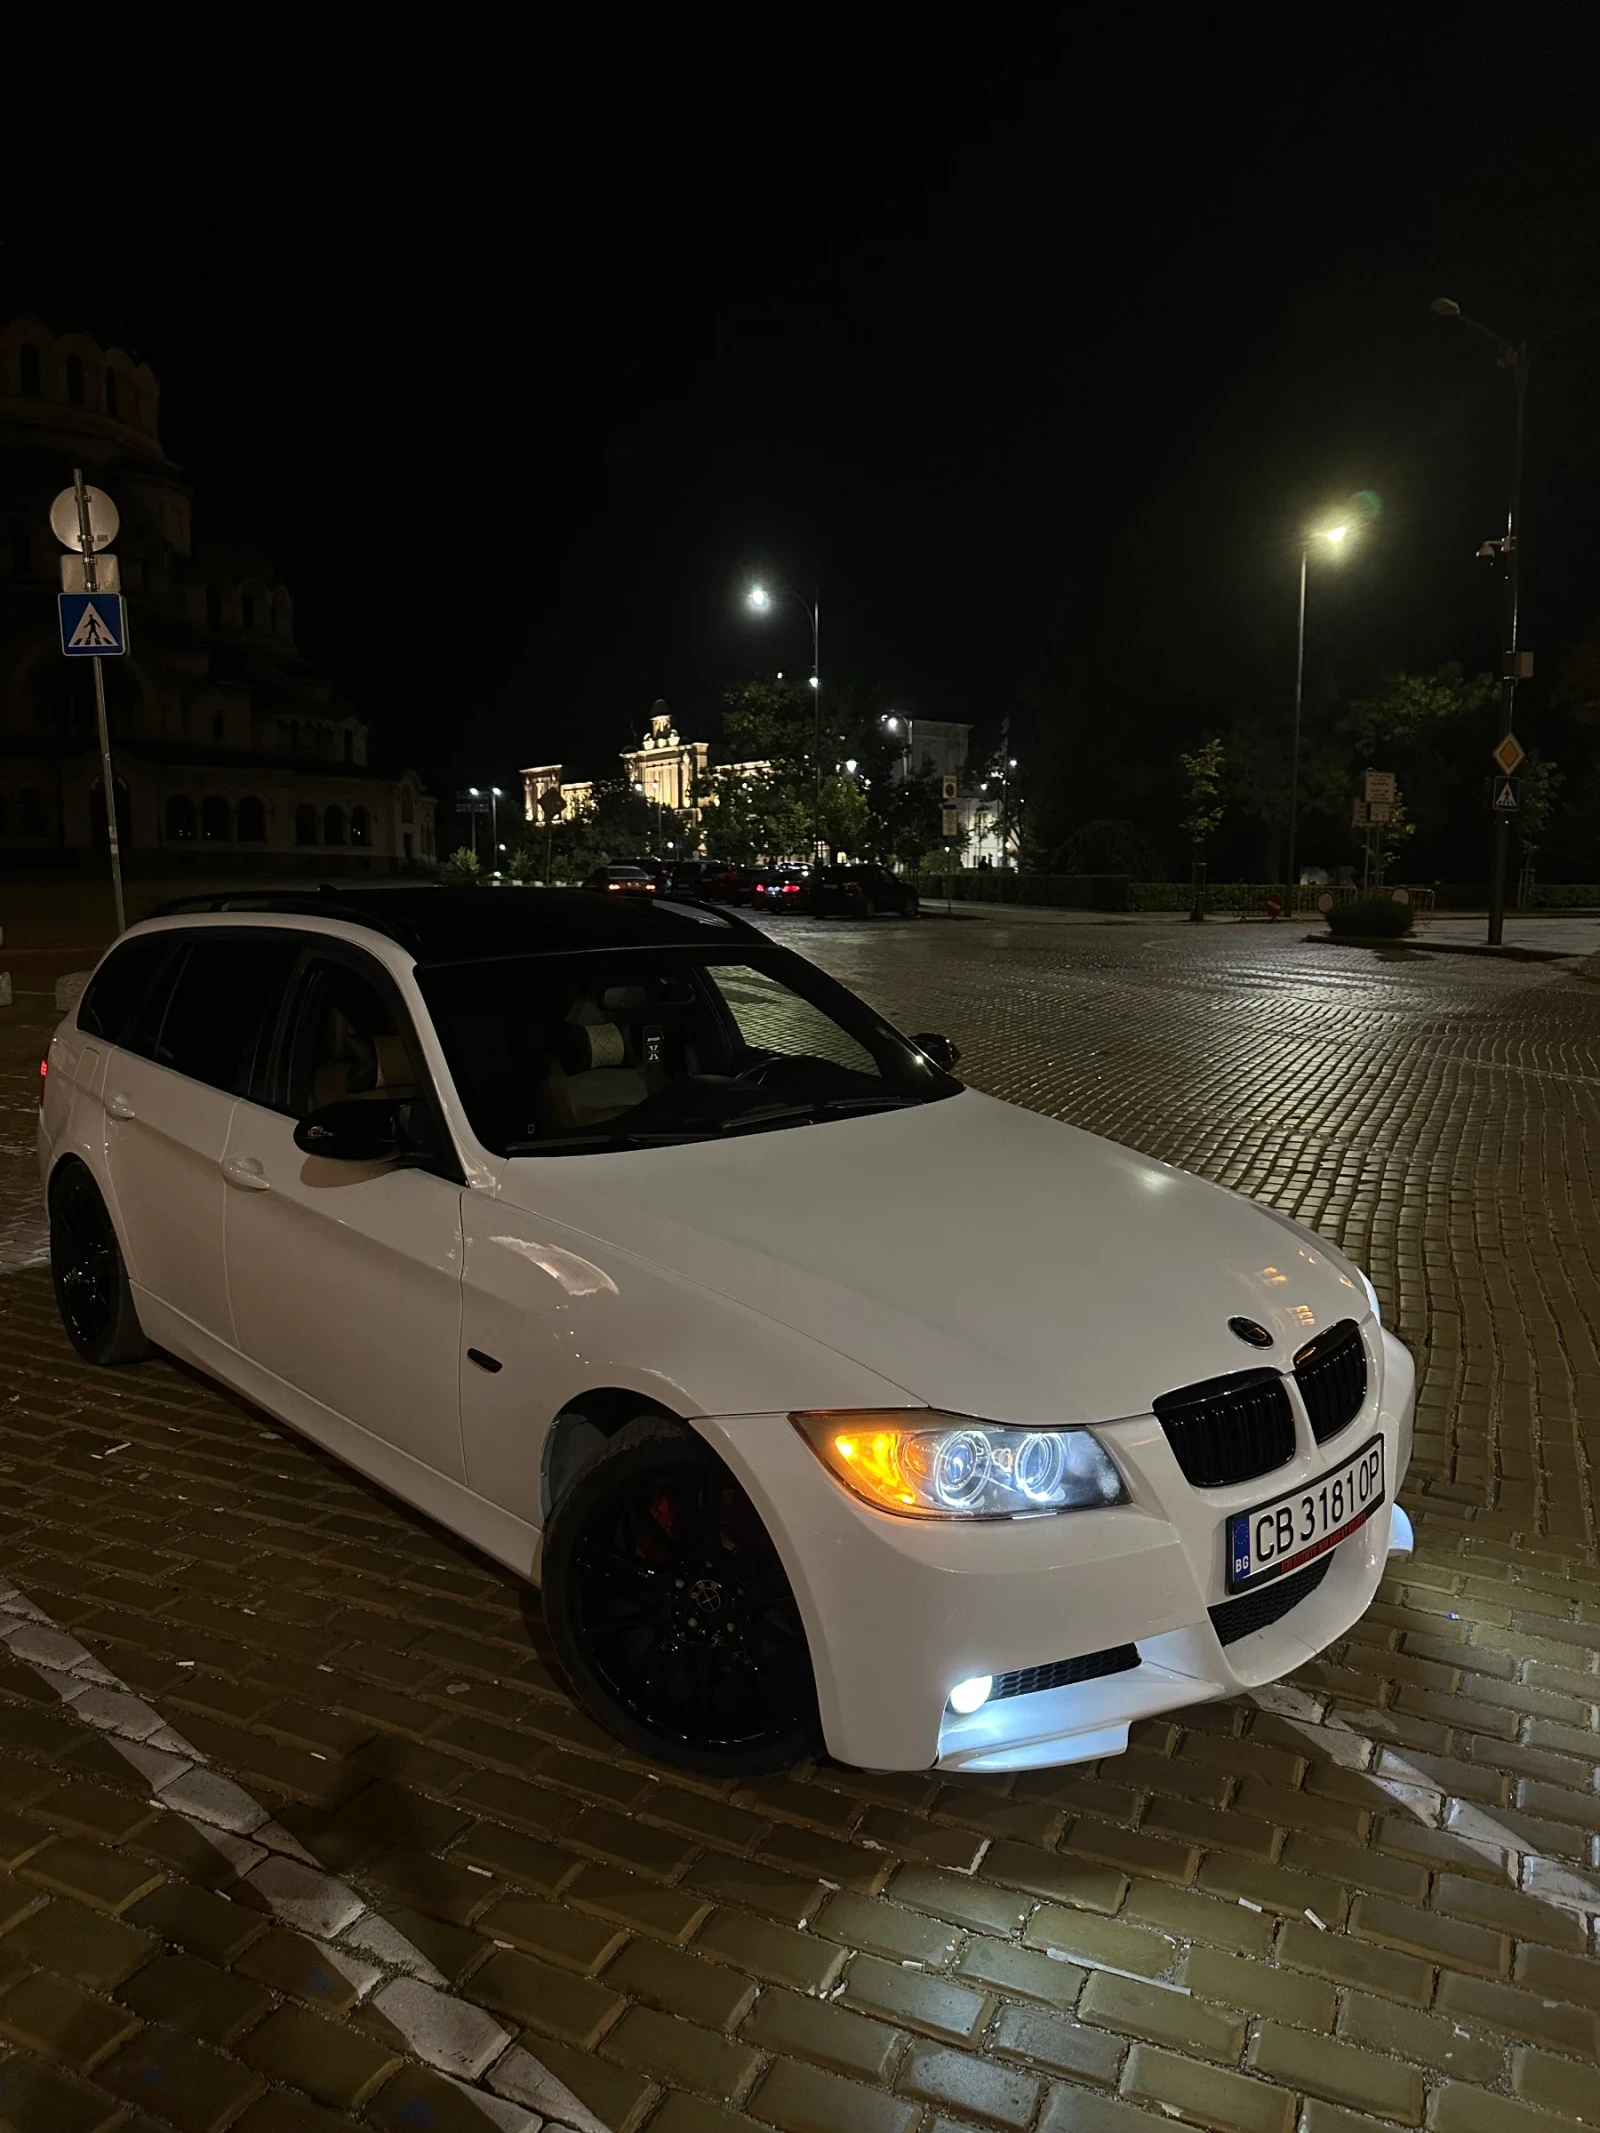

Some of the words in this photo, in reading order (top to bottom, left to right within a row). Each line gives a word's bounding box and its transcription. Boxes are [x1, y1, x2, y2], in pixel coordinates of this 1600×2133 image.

[1256, 1507, 1294, 1562] CB
[1300, 1470, 1354, 1541] 3181
[1235, 1555, 1249, 1574] BG
